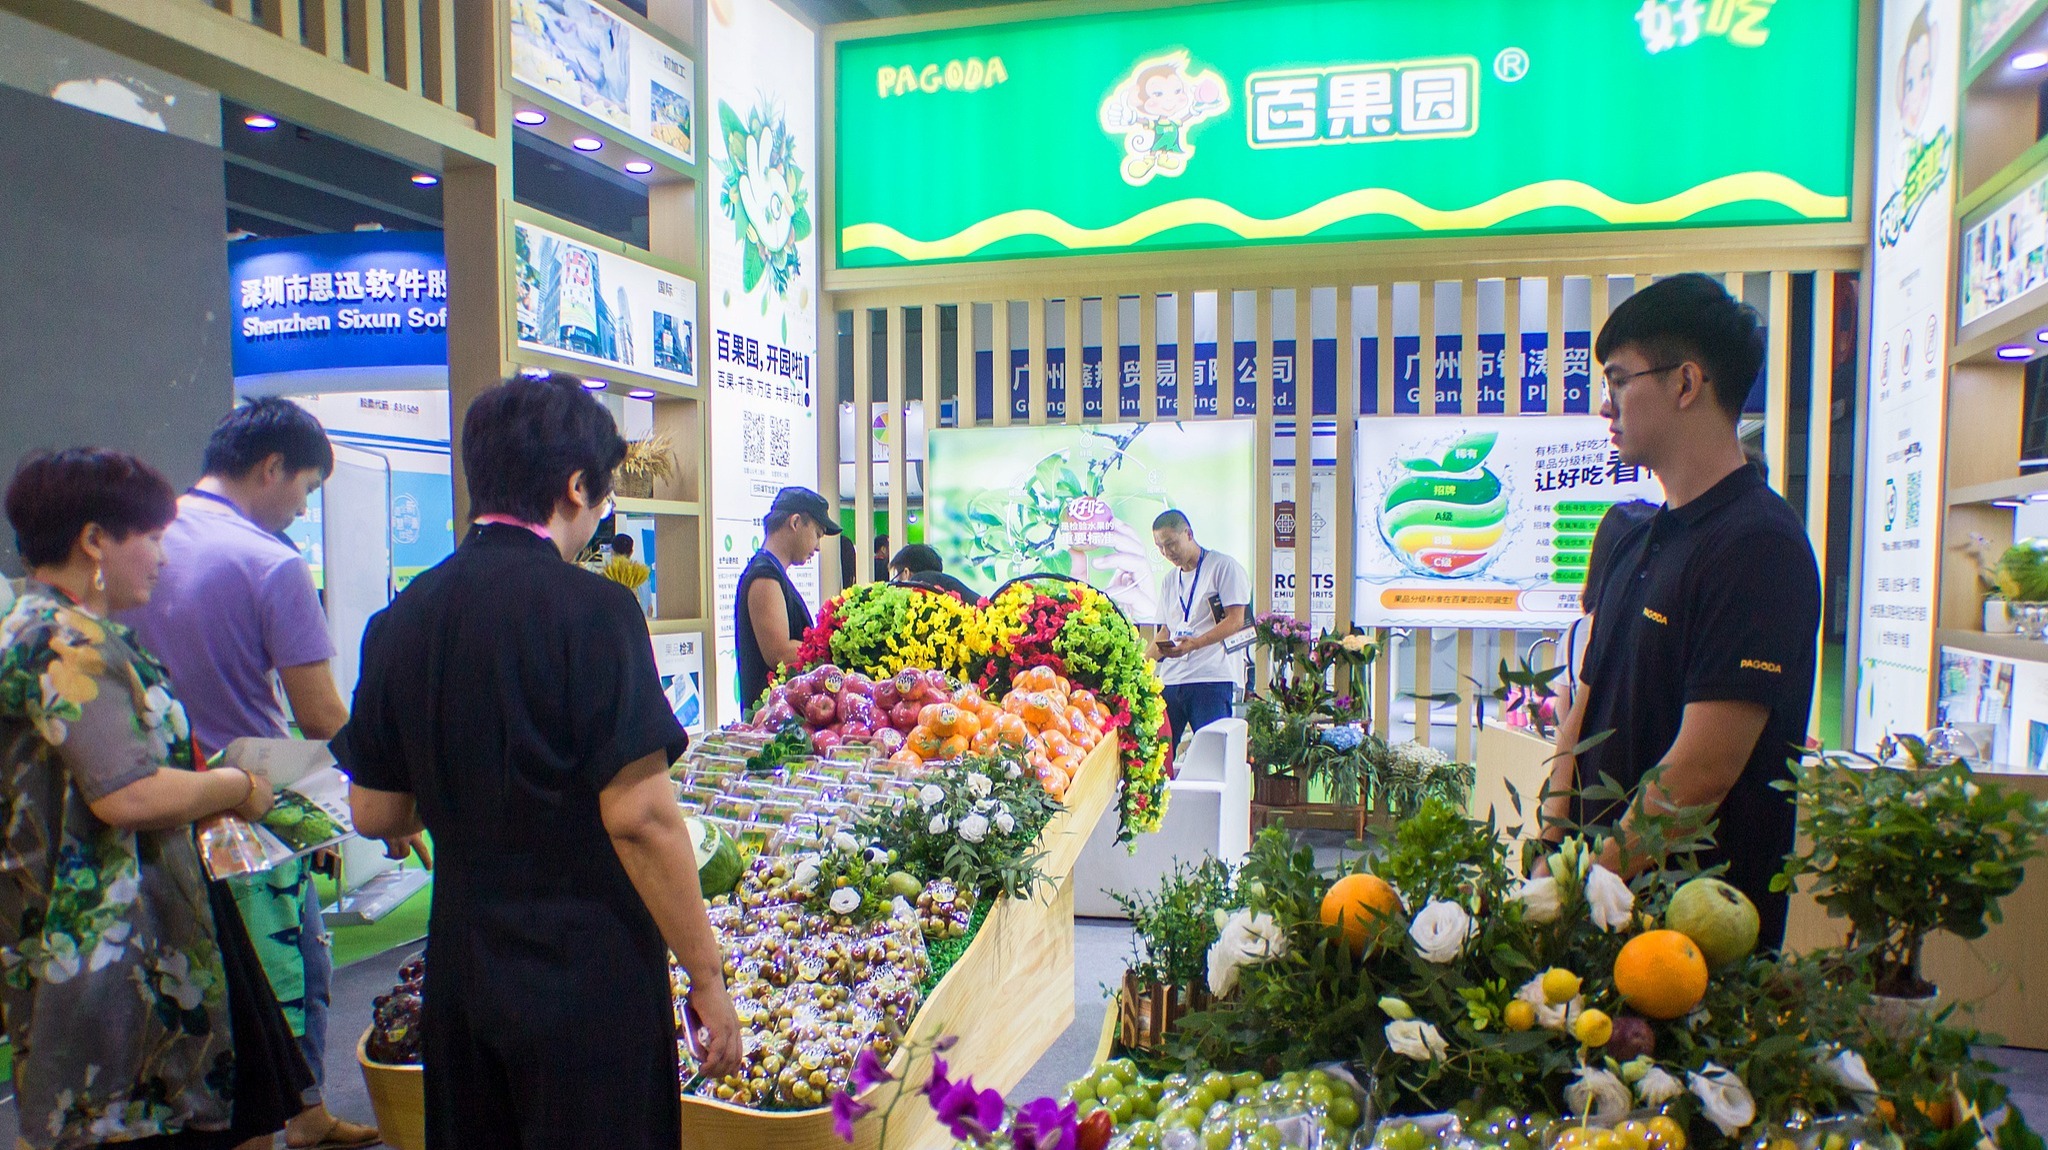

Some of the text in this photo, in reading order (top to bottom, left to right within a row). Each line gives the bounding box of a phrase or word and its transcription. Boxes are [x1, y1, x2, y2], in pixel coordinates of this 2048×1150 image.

[876, 56, 1008, 98] PAGODA
[1253, 66, 1468, 143] 百果园
[242, 312, 331, 337] Shenzhen
[338, 308, 400, 330] Sixun
[1157, 395, 1218, 411] Traing
[1534, 452, 1605, 471] 果品分级标准
[1433, 485, 1457, 496] 招牌
[1069, 500, 1106, 521] 好吃
[1435, 511, 1454, 522] A级
[1433, 536, 1453, 546] B级
[1433, 557, 1453, 568] C级
[1275, 574, 1334, 589] ROTS
[1740, 659, 1782, 673] PAGODA
